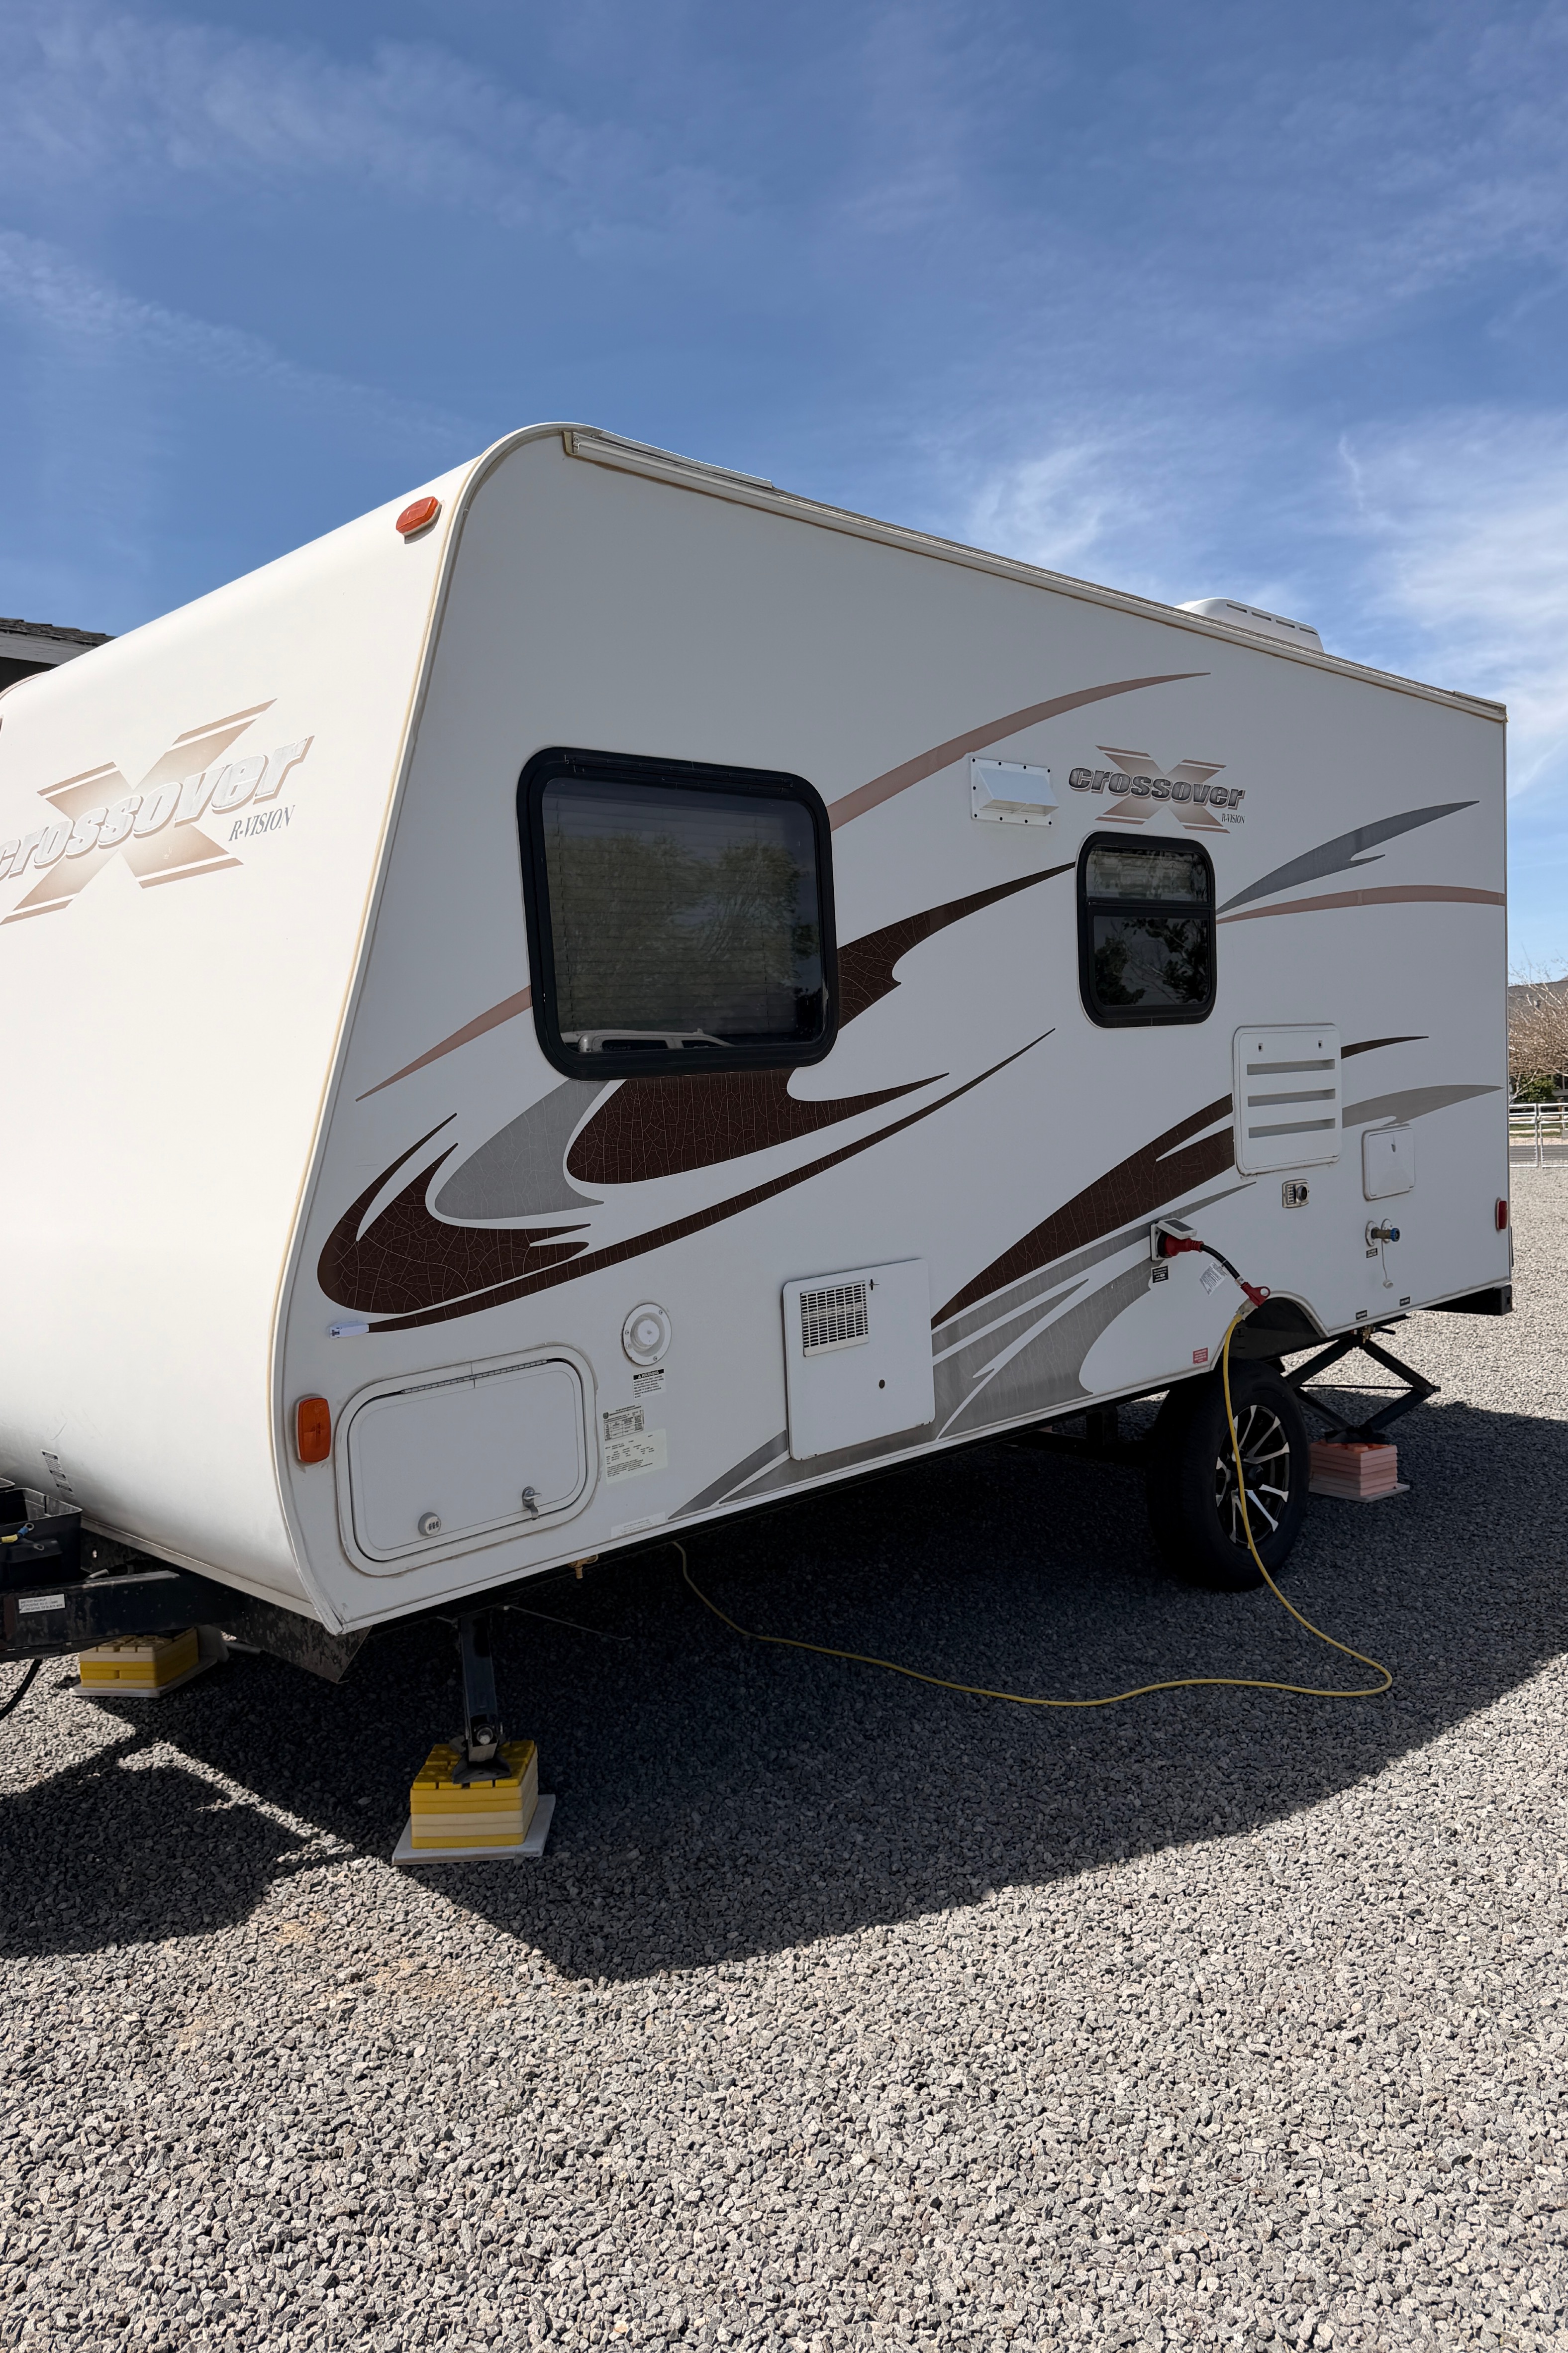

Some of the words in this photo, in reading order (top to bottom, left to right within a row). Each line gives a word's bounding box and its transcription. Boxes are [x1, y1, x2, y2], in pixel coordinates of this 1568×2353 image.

[0, 735, 315, 882] crossover
[1068, 767, 1247, 811] crossover
[228, 805, 295, 841] R-VISION
[1222, 813, 1245, 824] R-VISION
